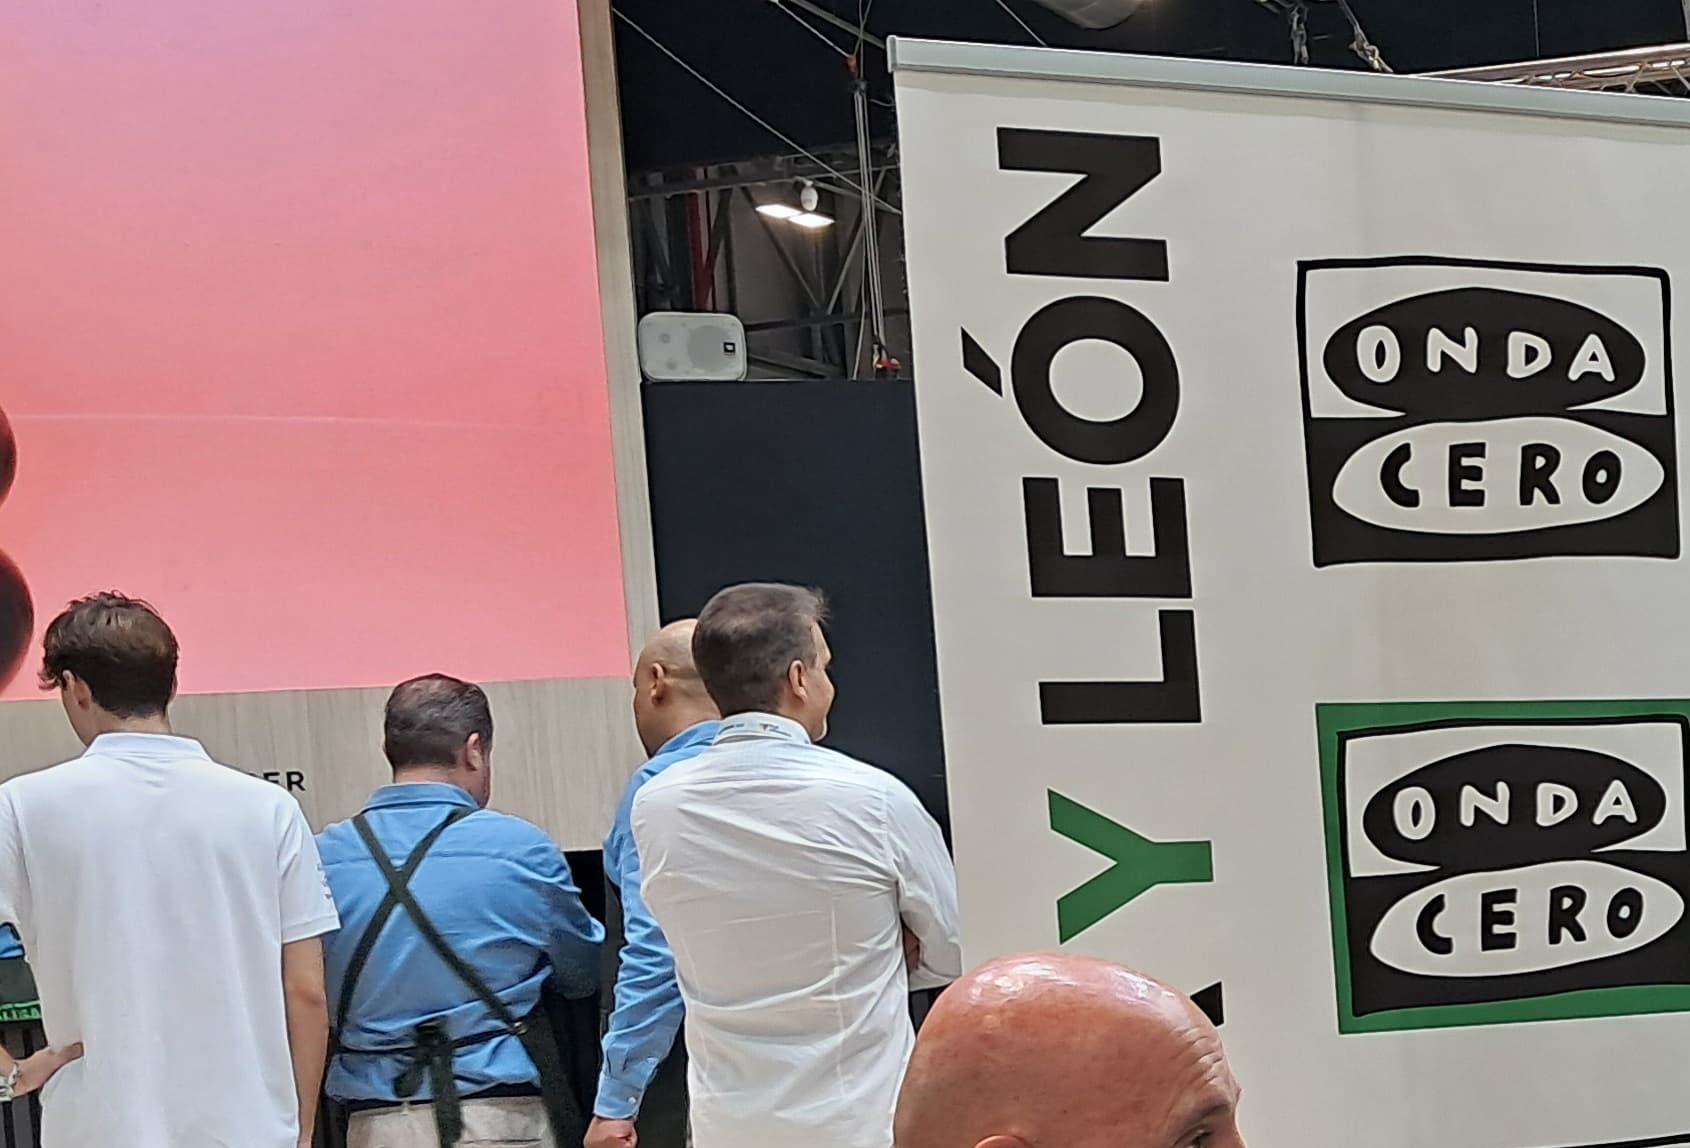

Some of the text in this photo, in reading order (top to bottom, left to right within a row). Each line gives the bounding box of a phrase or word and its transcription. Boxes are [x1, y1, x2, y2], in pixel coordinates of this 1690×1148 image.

[1356, 324, 1615, 384] ONDA
[1380, 441, 1622, 508] CERO
[961, 127, 1214, 944] Y LEÓN
[1392, 780, 1638, 841] ONDA
[1415, 886, 1644, 955] CERO
